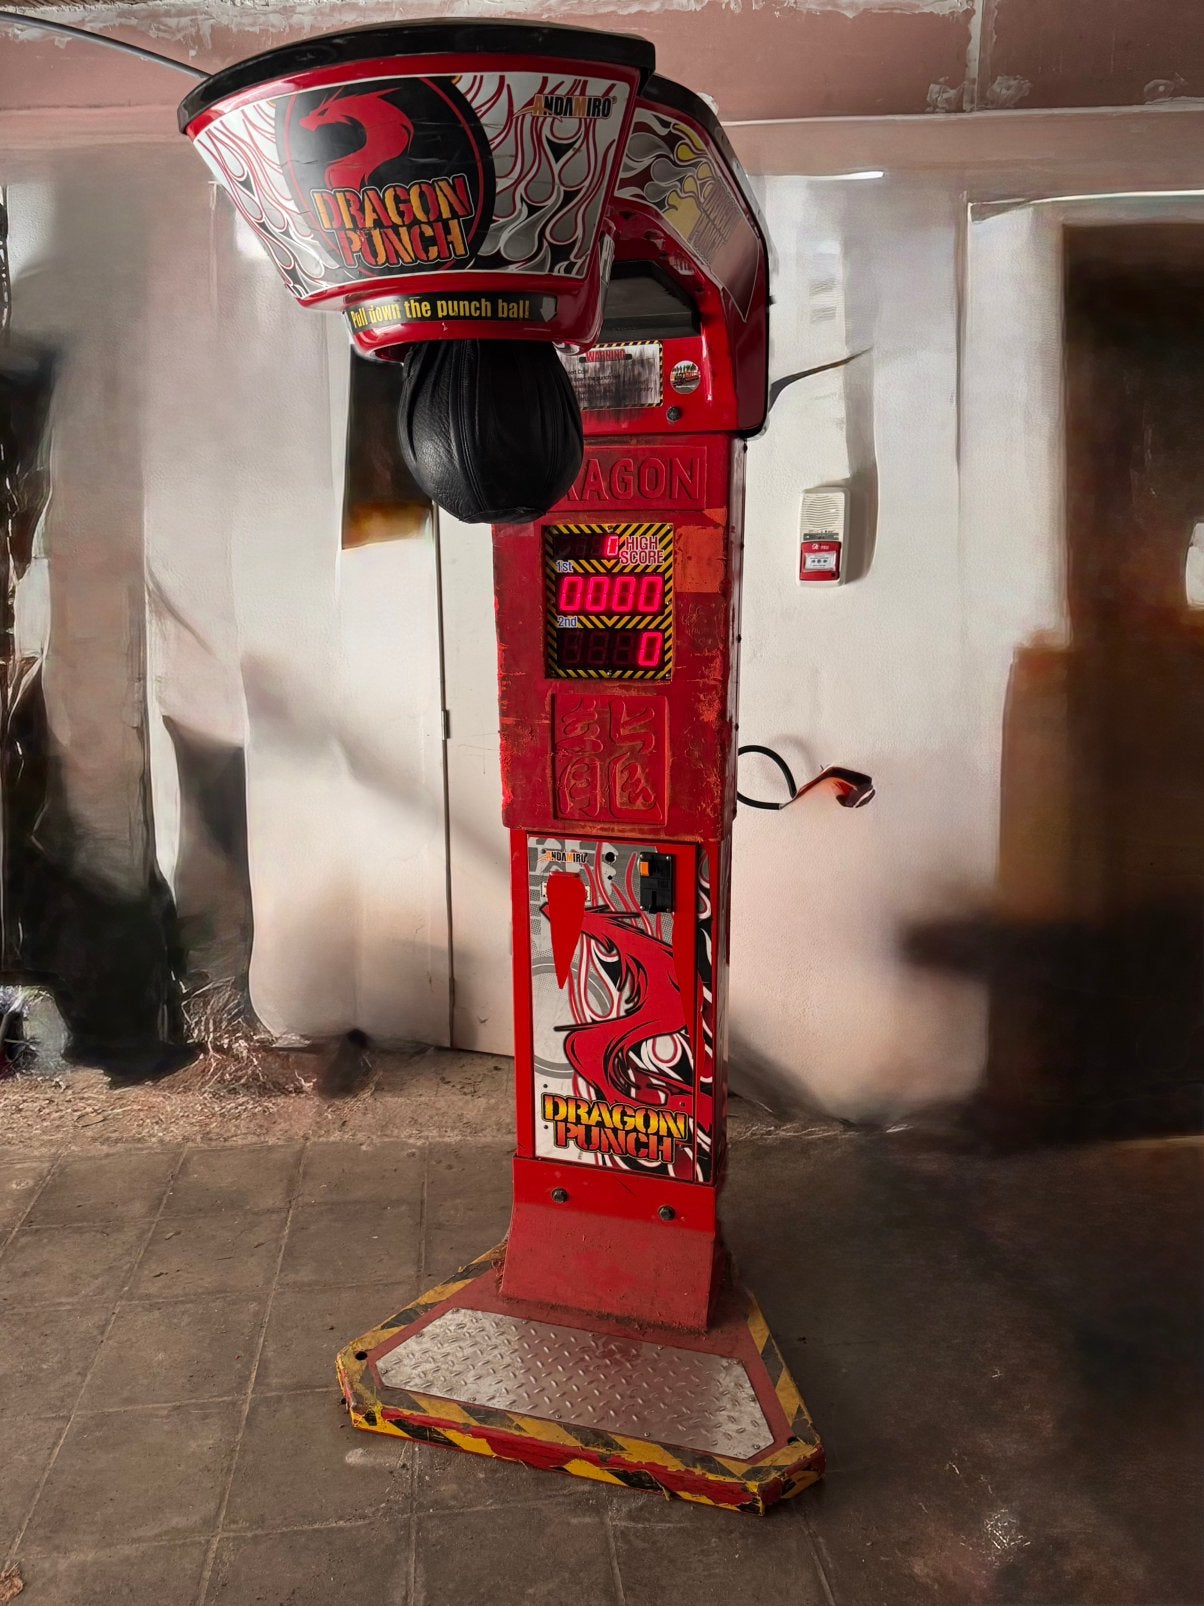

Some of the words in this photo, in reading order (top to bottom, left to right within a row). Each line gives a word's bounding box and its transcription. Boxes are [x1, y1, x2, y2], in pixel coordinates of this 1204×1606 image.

[531, 94, 612, 119] ANDAMIRO
[312, 175, 473, 231] DRAGON
[337, 218, 467, 267] PUNCH
[350, 307, 368, 328] Pull
[369, 303, 401, 323] down
[404, 299, 432, 318] the
[437, 298, 492, 319] punch
[567, 457, 700, 501] AGON
[606, 535, 620, 557] 0
[620, 550, 664, 565] SCORE
[626, 536, 658, 551] HIGH
[557, 561, 573, 572] 1st
[559, 576, 663, 612] 0000
[558, 616, 578, 628] 2nd
[638, 631, 663, 667] 0
[543, 1095, 686, 1139] DRAGON
[555, 1120, 673, 1163] PUNCH
